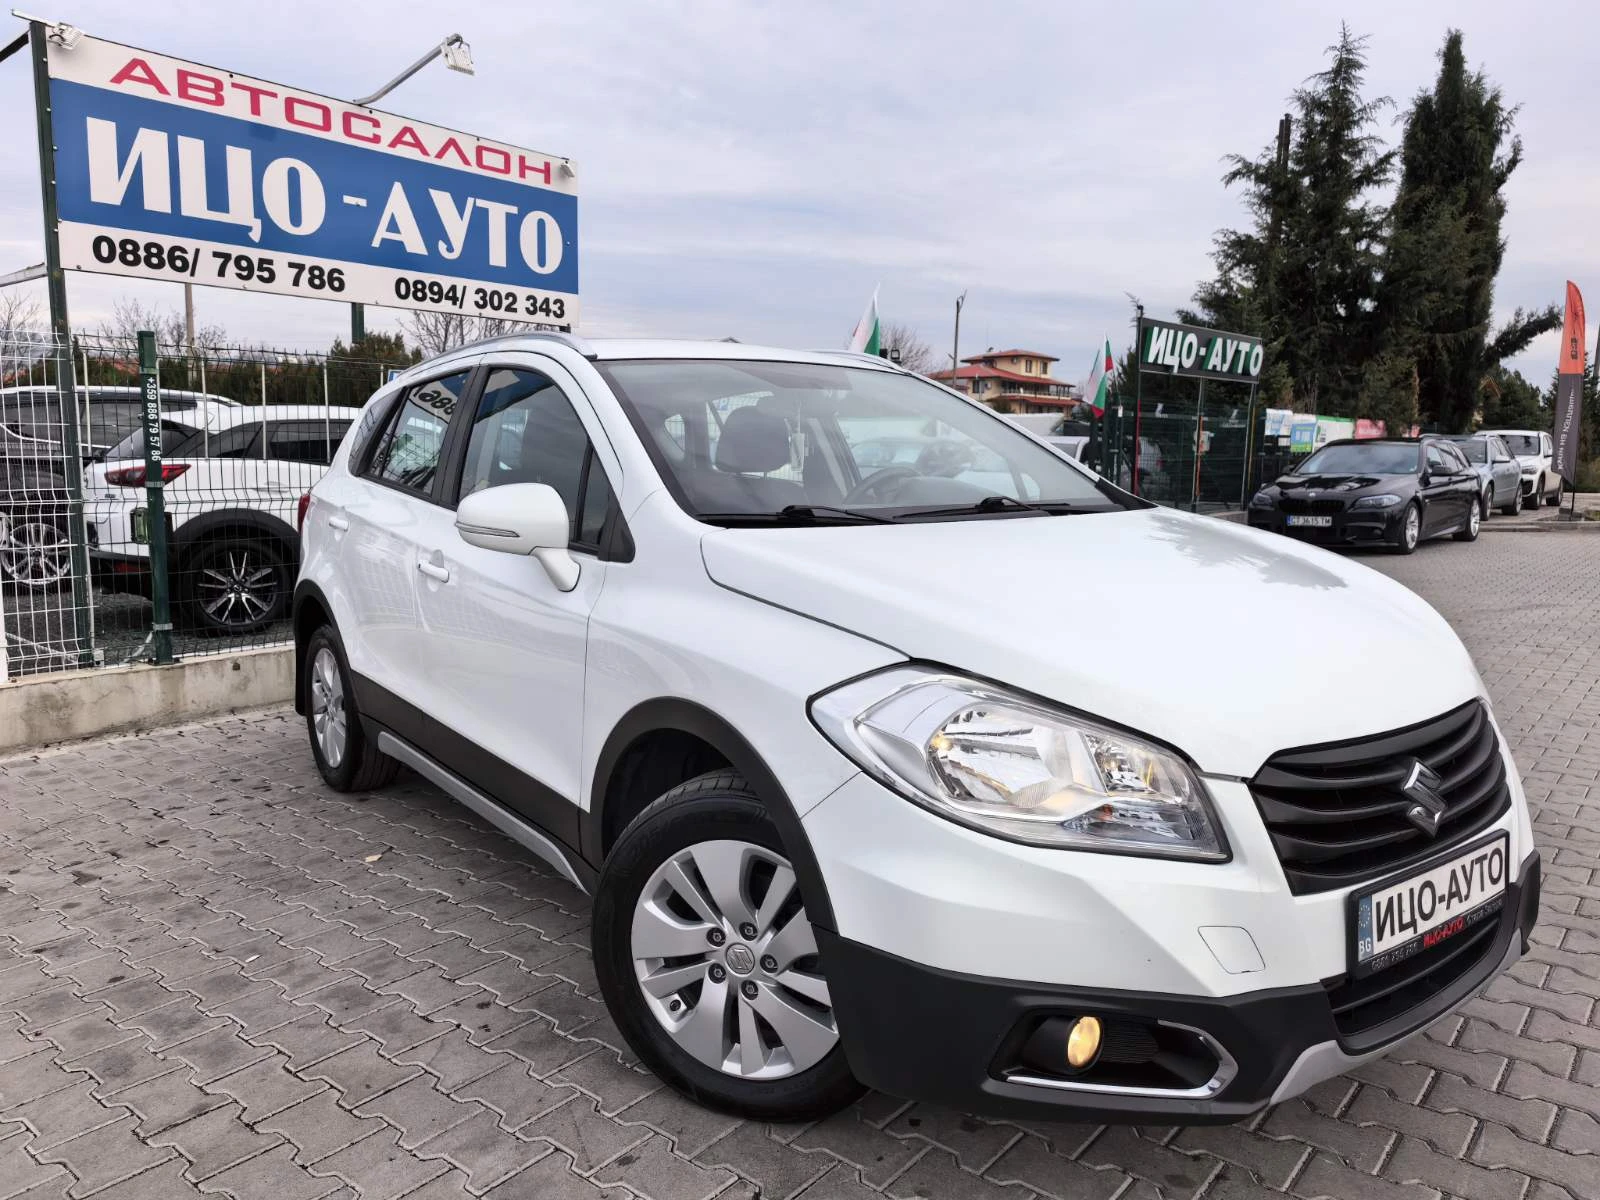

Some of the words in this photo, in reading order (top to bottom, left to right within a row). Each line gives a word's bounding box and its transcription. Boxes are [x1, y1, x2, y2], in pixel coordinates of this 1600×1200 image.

[110, 58, 551, 185] АВТОСАЛОН
[92, 235, 200, 277] 0886/
[212, 251, 276, 284] 795
[287, 262, 346, 293] 786
[394, 277, 467, 309] 0894/
[474, 287, 518, 313] 302
[524, 295, 565, 319] 343
[1147, 326, 1264, 377] ИЦО-АУТО
[146, 376, 157, 400] +359
[147, 402, 158, 420] 886
[148, 422, 159, 434] 79
[149, 436, 160, 447] 57
[151, 449, 162, 462] 86
[1375, 847, 1503, 943] ИЦО-АУТО
[1359, 937, 1372, 955] BG
